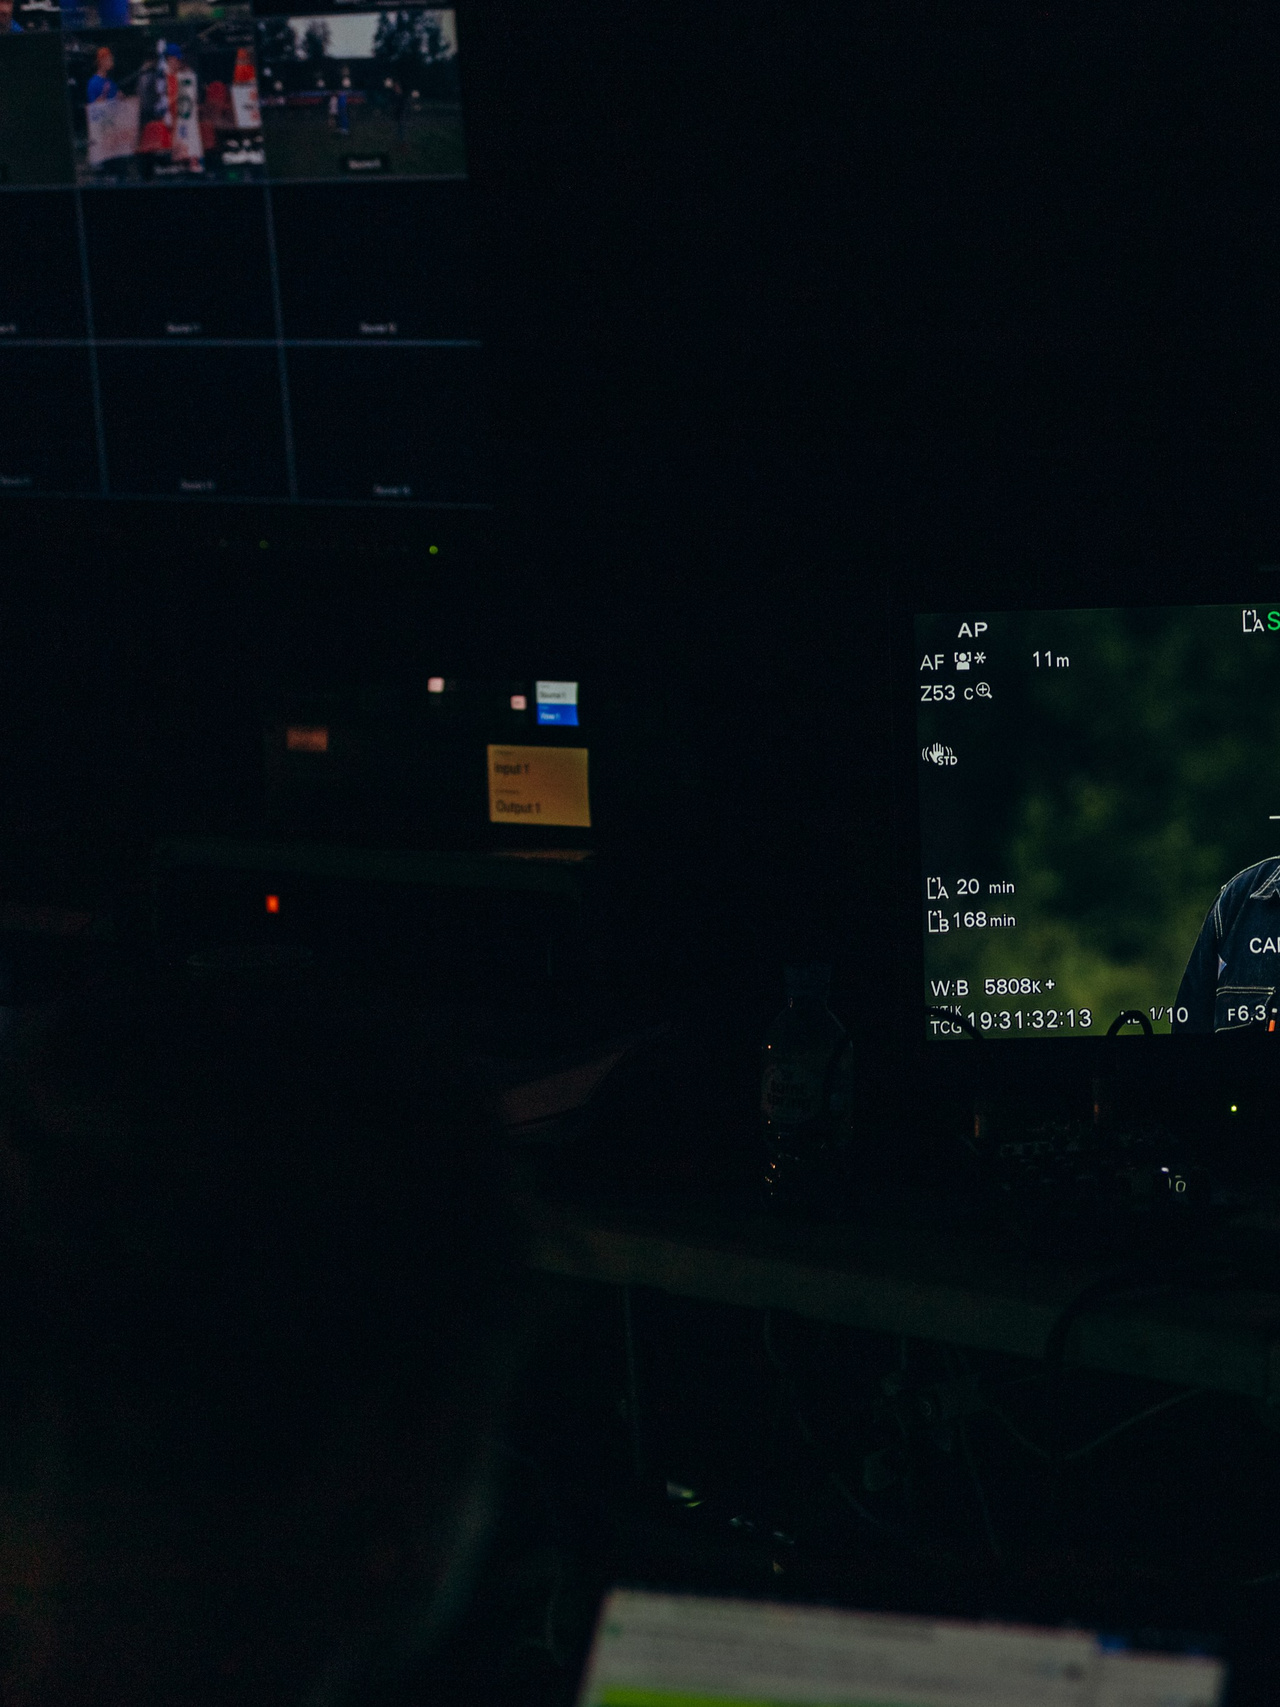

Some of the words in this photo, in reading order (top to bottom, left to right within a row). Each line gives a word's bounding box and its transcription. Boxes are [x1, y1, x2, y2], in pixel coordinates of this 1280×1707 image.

[957, 621, 988, 638] AP
[920, 654, 945, 671] AF
[920, 684, 956, 702] Z53
[938, 755, 958, 766] STD
[496, 800, 532, 815] Output
[956, 878, 980, 895] 20
[989, 880, 1015, 894] min
[953, 911, 987, 928] 168
[990, 913, 1016, 927] min
[930, 1020, 963, 1035] TCG
[967, 1008, 1092, 1031] 19:31:32:13
[1149, 1006, 1189, 1024] 1/10
